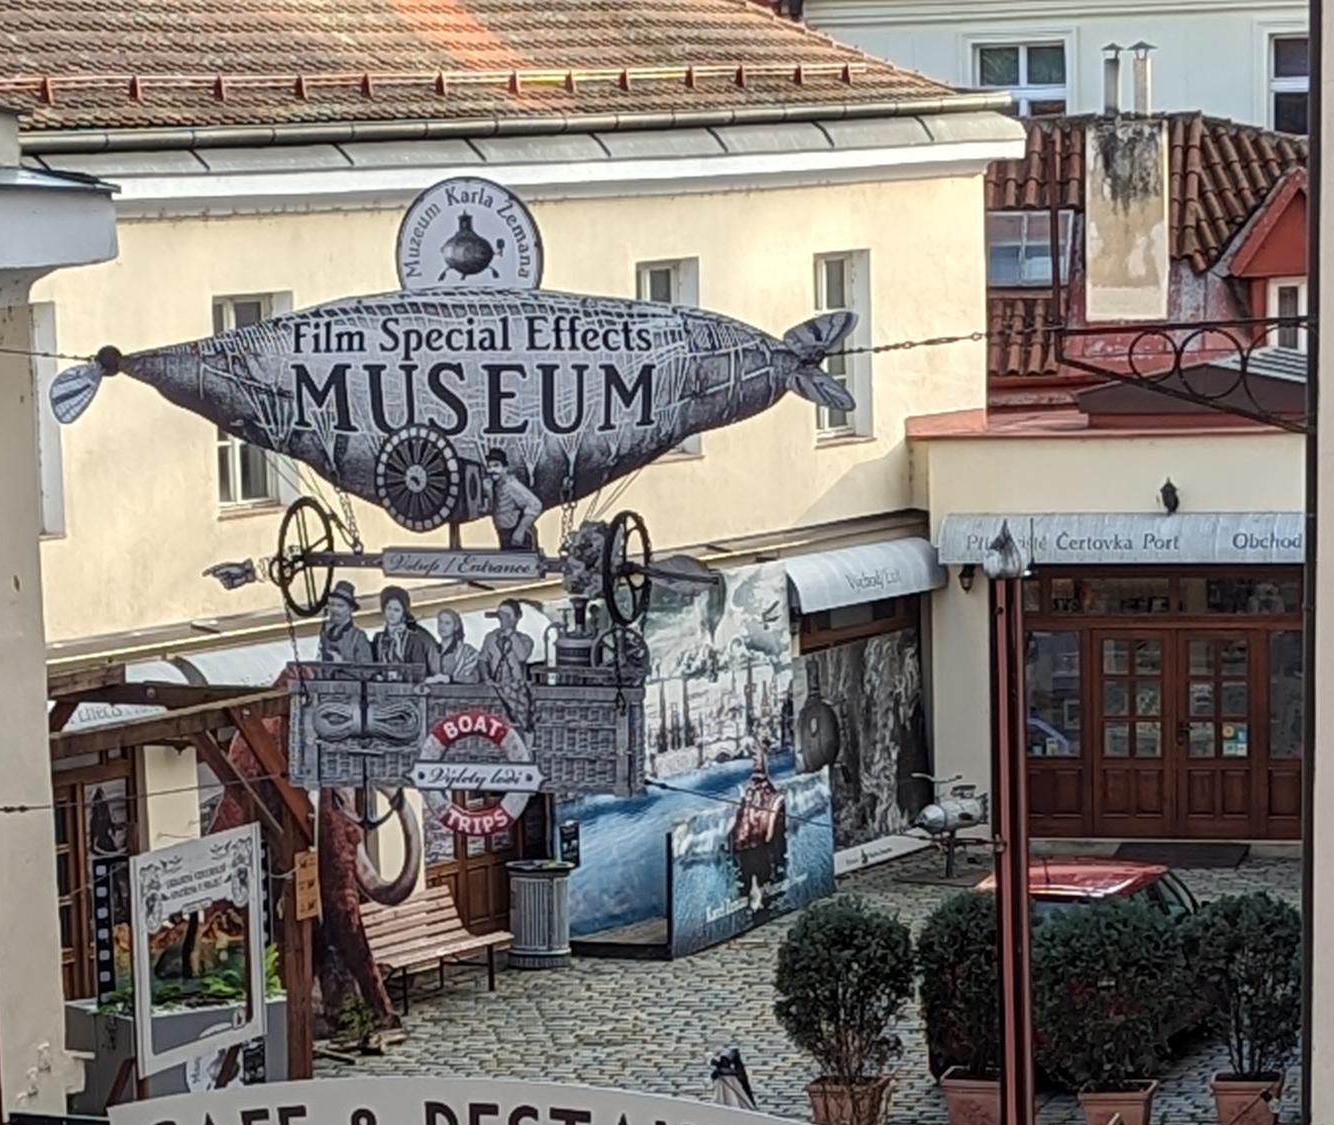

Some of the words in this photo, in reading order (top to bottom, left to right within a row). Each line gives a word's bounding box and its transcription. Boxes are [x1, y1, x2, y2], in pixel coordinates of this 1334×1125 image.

[403, 203, 441, 279] Muzeum
[445, 186, 494, 208] Karla
[496, 200, 532, 279] Zemana
[291, 322, 366, 354] Film
[379, 316, 511, 360] Special
[525, 316, 653, 352] Effects
[290, 362, 656, 436] MUSEUM
[1055, 531, 1134, 551] Čertovka
[1143, 533, 1180, 550] Port
[1232, 532, 1302, 549] Obchod
[457, 554, 531, 574] Entrance
[442, 715, 503, 740] BOAT
[447, 808, 509, 834] TRIPS
